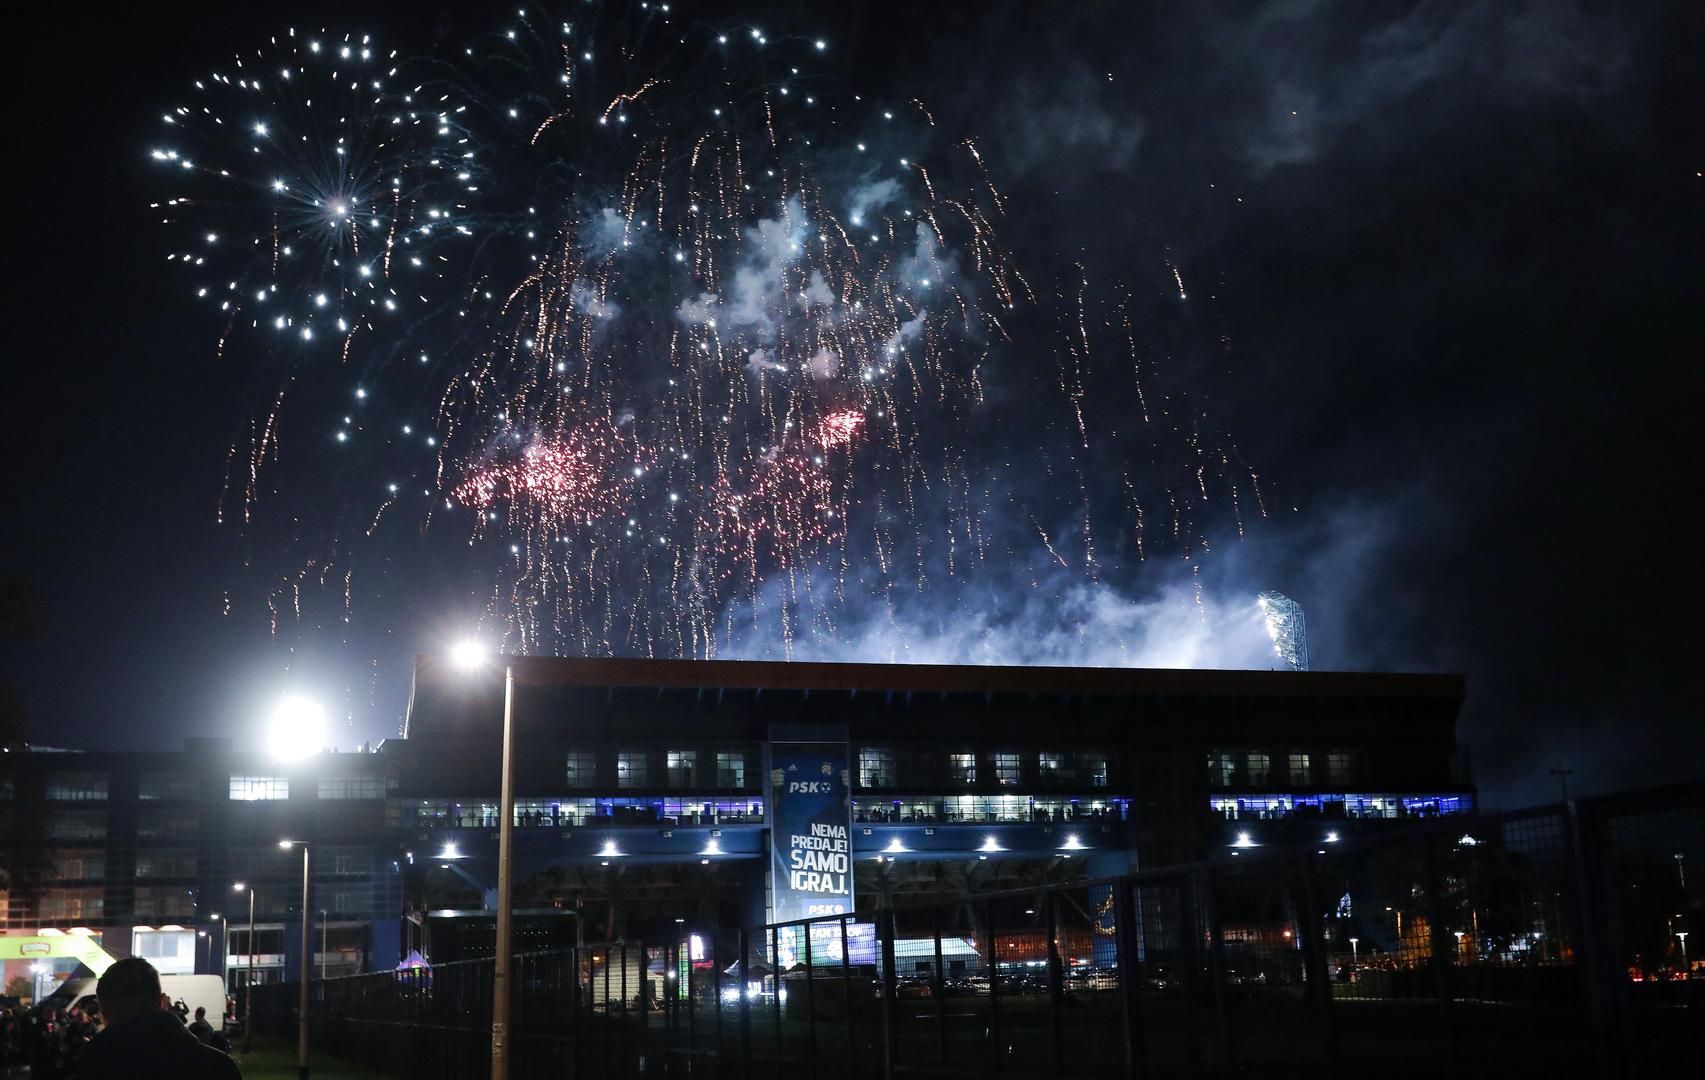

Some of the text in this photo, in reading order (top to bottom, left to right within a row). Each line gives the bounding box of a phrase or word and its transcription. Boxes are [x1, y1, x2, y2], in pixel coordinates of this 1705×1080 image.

[789, 781, 820, 793] PSK
[811, 823, 847, 839] NEMA
[791, 835, 848, 853] PREDAJE!
[791, 849, 848, 874] SAMO
[790, 870, 849, 895] IGRAJ.
[808, 904, 835, 915] PSK
